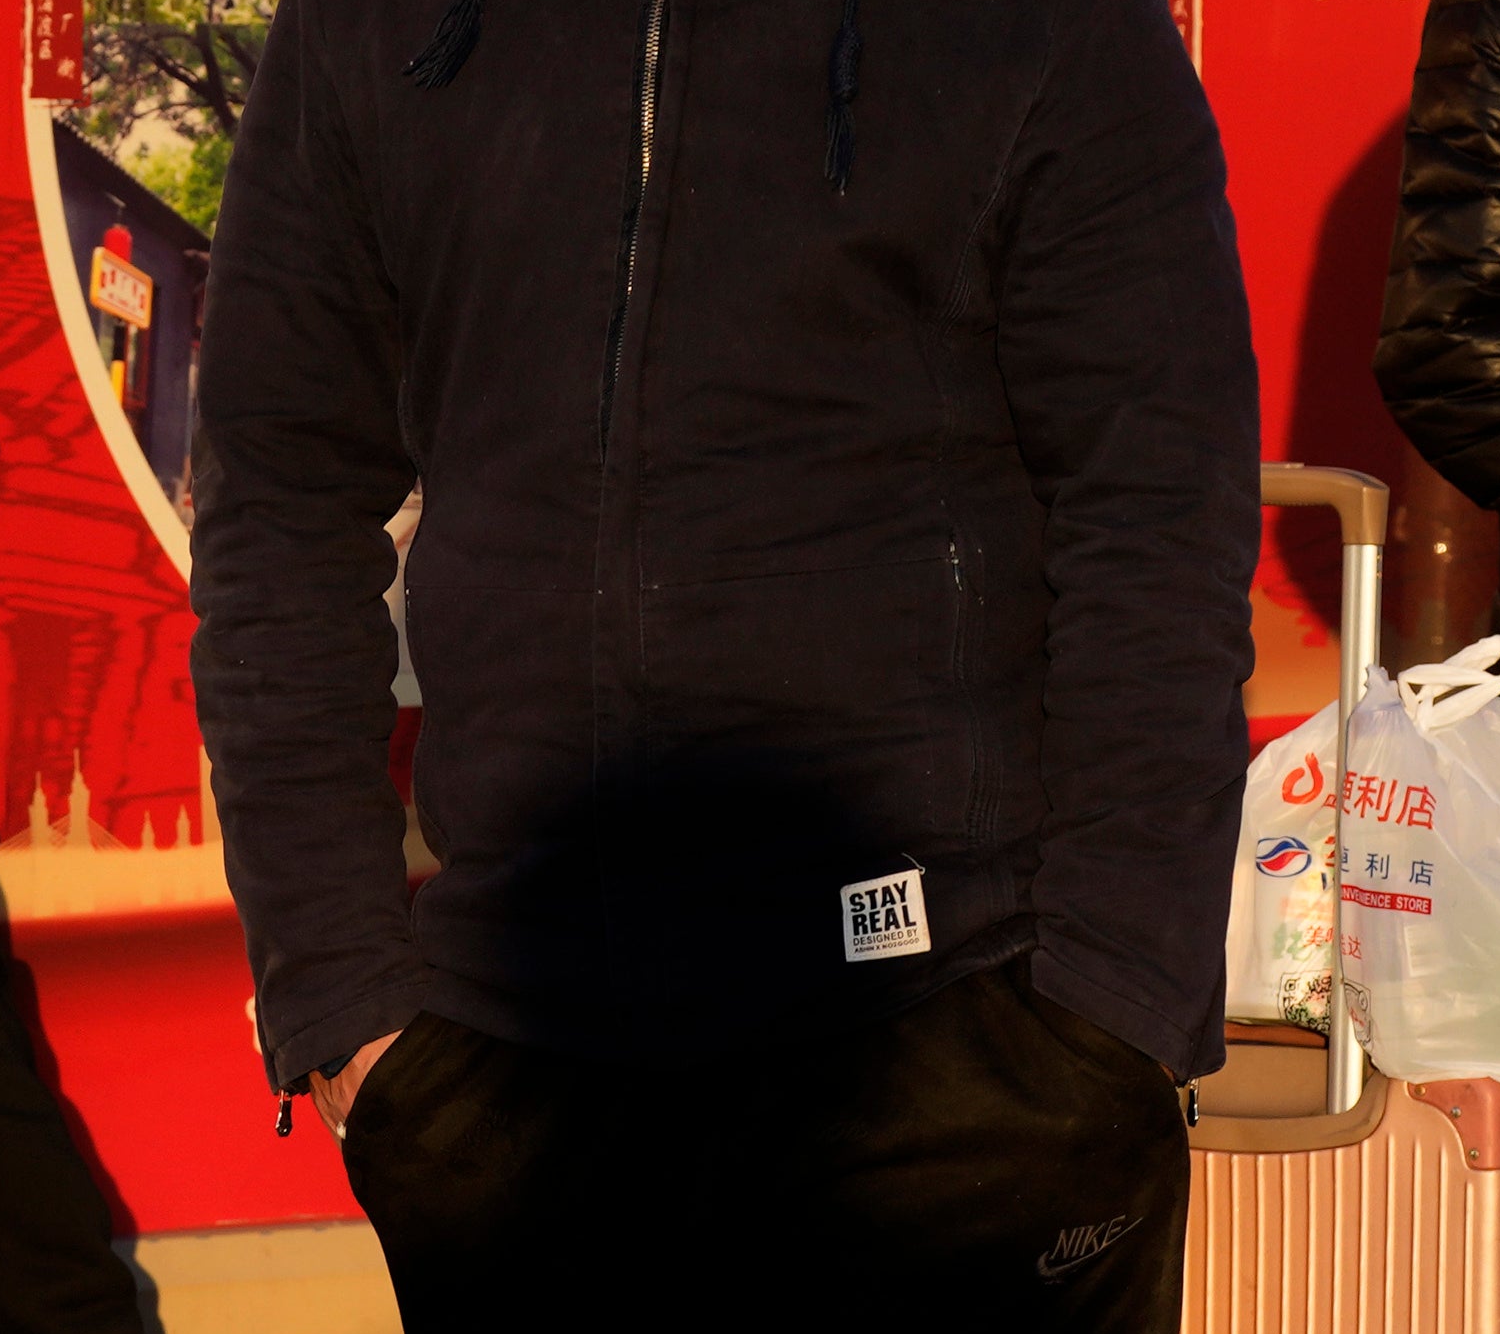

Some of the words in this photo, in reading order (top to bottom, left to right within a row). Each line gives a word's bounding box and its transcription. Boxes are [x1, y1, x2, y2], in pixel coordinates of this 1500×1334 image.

[850, 879, 909, 913] STAY
[1396, 896, 1430, 914] STORE
[852, 905, 917, 936] REAL
[853, 930, 904, 947] DESIGNED
[907, 928, 918, 938] BY
[1048, 1213, 1127, 1261] NIKE
